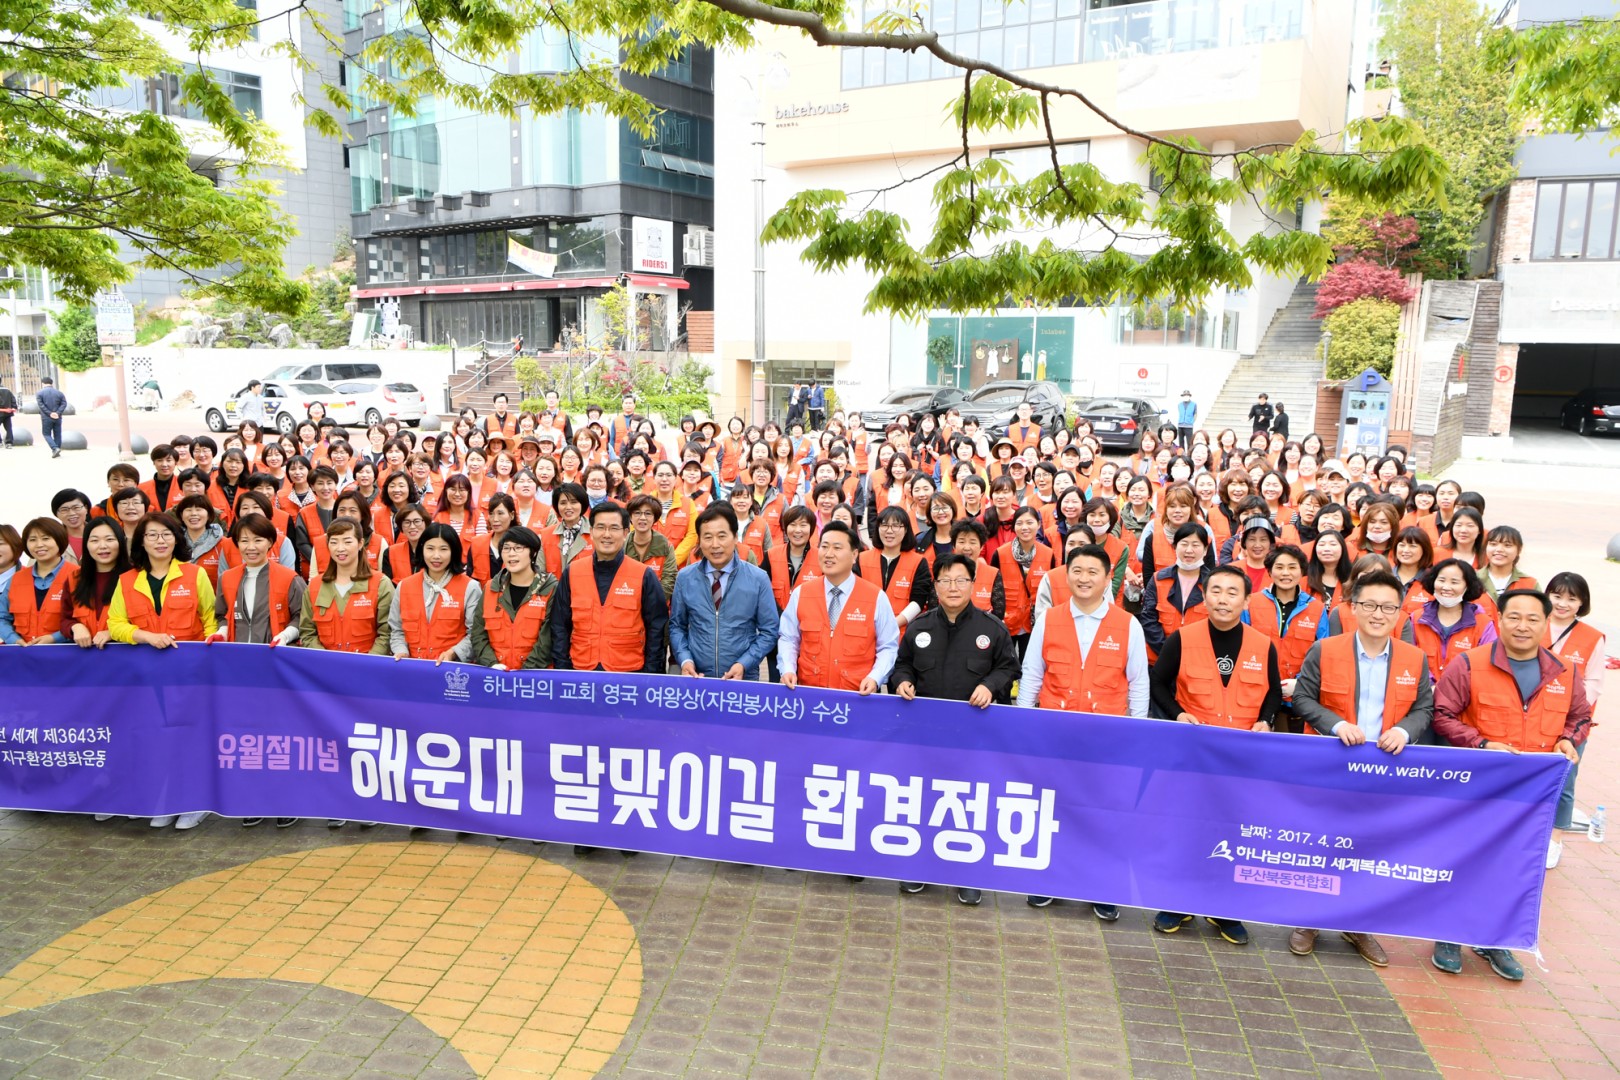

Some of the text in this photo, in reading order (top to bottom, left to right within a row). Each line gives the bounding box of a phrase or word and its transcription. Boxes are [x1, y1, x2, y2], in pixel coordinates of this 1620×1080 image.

[775, 101, 850, 120] bakehouse
[1361, 371, 1382, 391] P
[483, 675, 851, 725] 하나님의 교회 영국 여왕상(자원봉사상) 수상
[11, 727, 39, 744] 세계
[43, 726, 112, 744] 제3643차
[1, 749, 107, 768] 지구환경정화운동
[218, 733, 340, 773] 유월절기념
[1347, 761, 1472, 783] www.watv.org
[347, 722, 1060, 871] 해운대 달맞이길 환경정화
[1240, 823, 1355, 851] 날짜: 2017. 4. 20.
[1236, 845, 1454, 883] 하나님의교회 세계복음선교협회
[1239, 868, 1334, 892] 부산북동연합회
